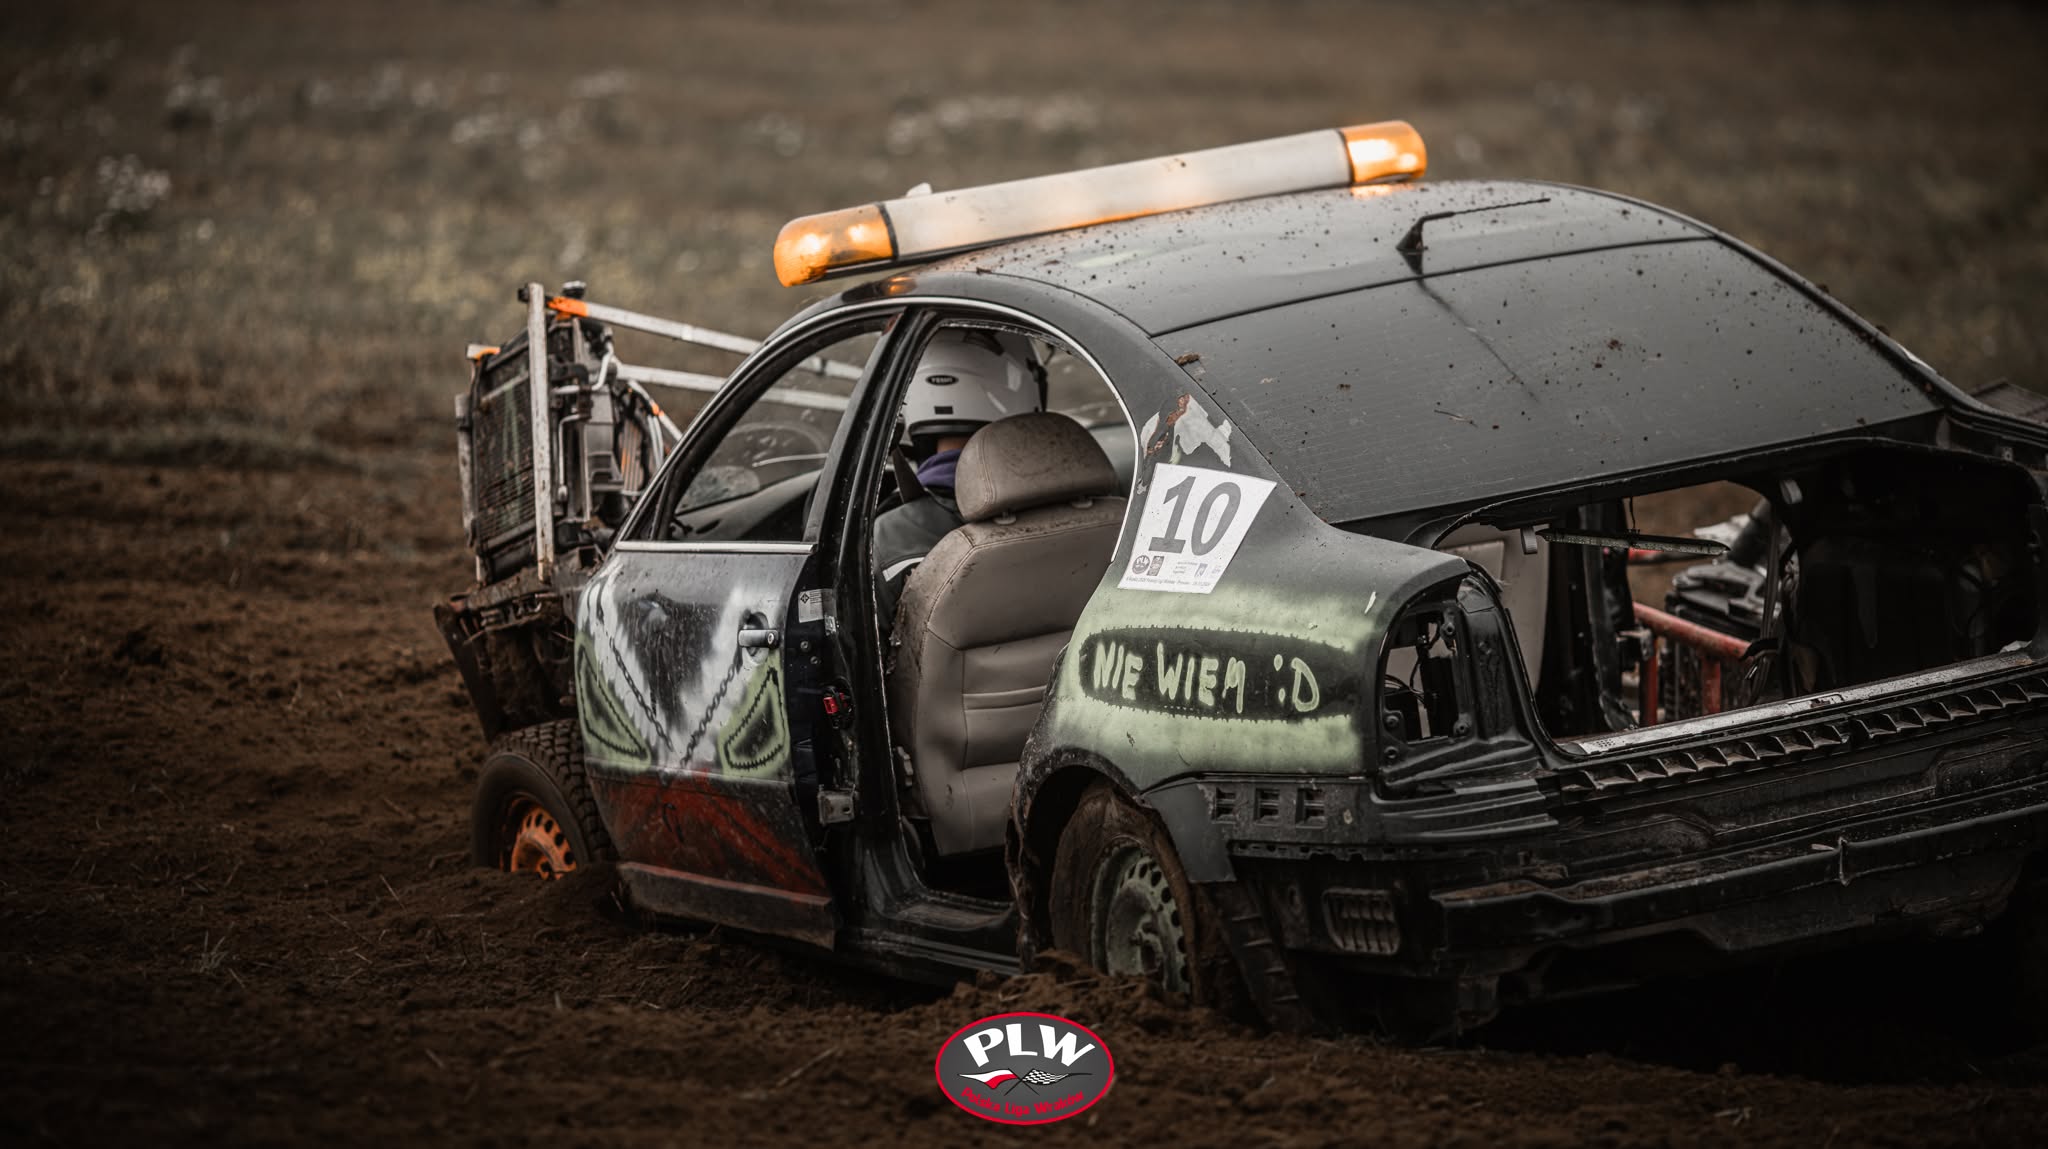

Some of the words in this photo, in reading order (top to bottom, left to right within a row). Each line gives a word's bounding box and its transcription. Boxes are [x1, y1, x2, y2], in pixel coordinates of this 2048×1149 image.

[1148, 475, 1242, 556] 10
[1094, 641, 1143, 700] NIE
[1157, 642, 1246, 713] WIEM
